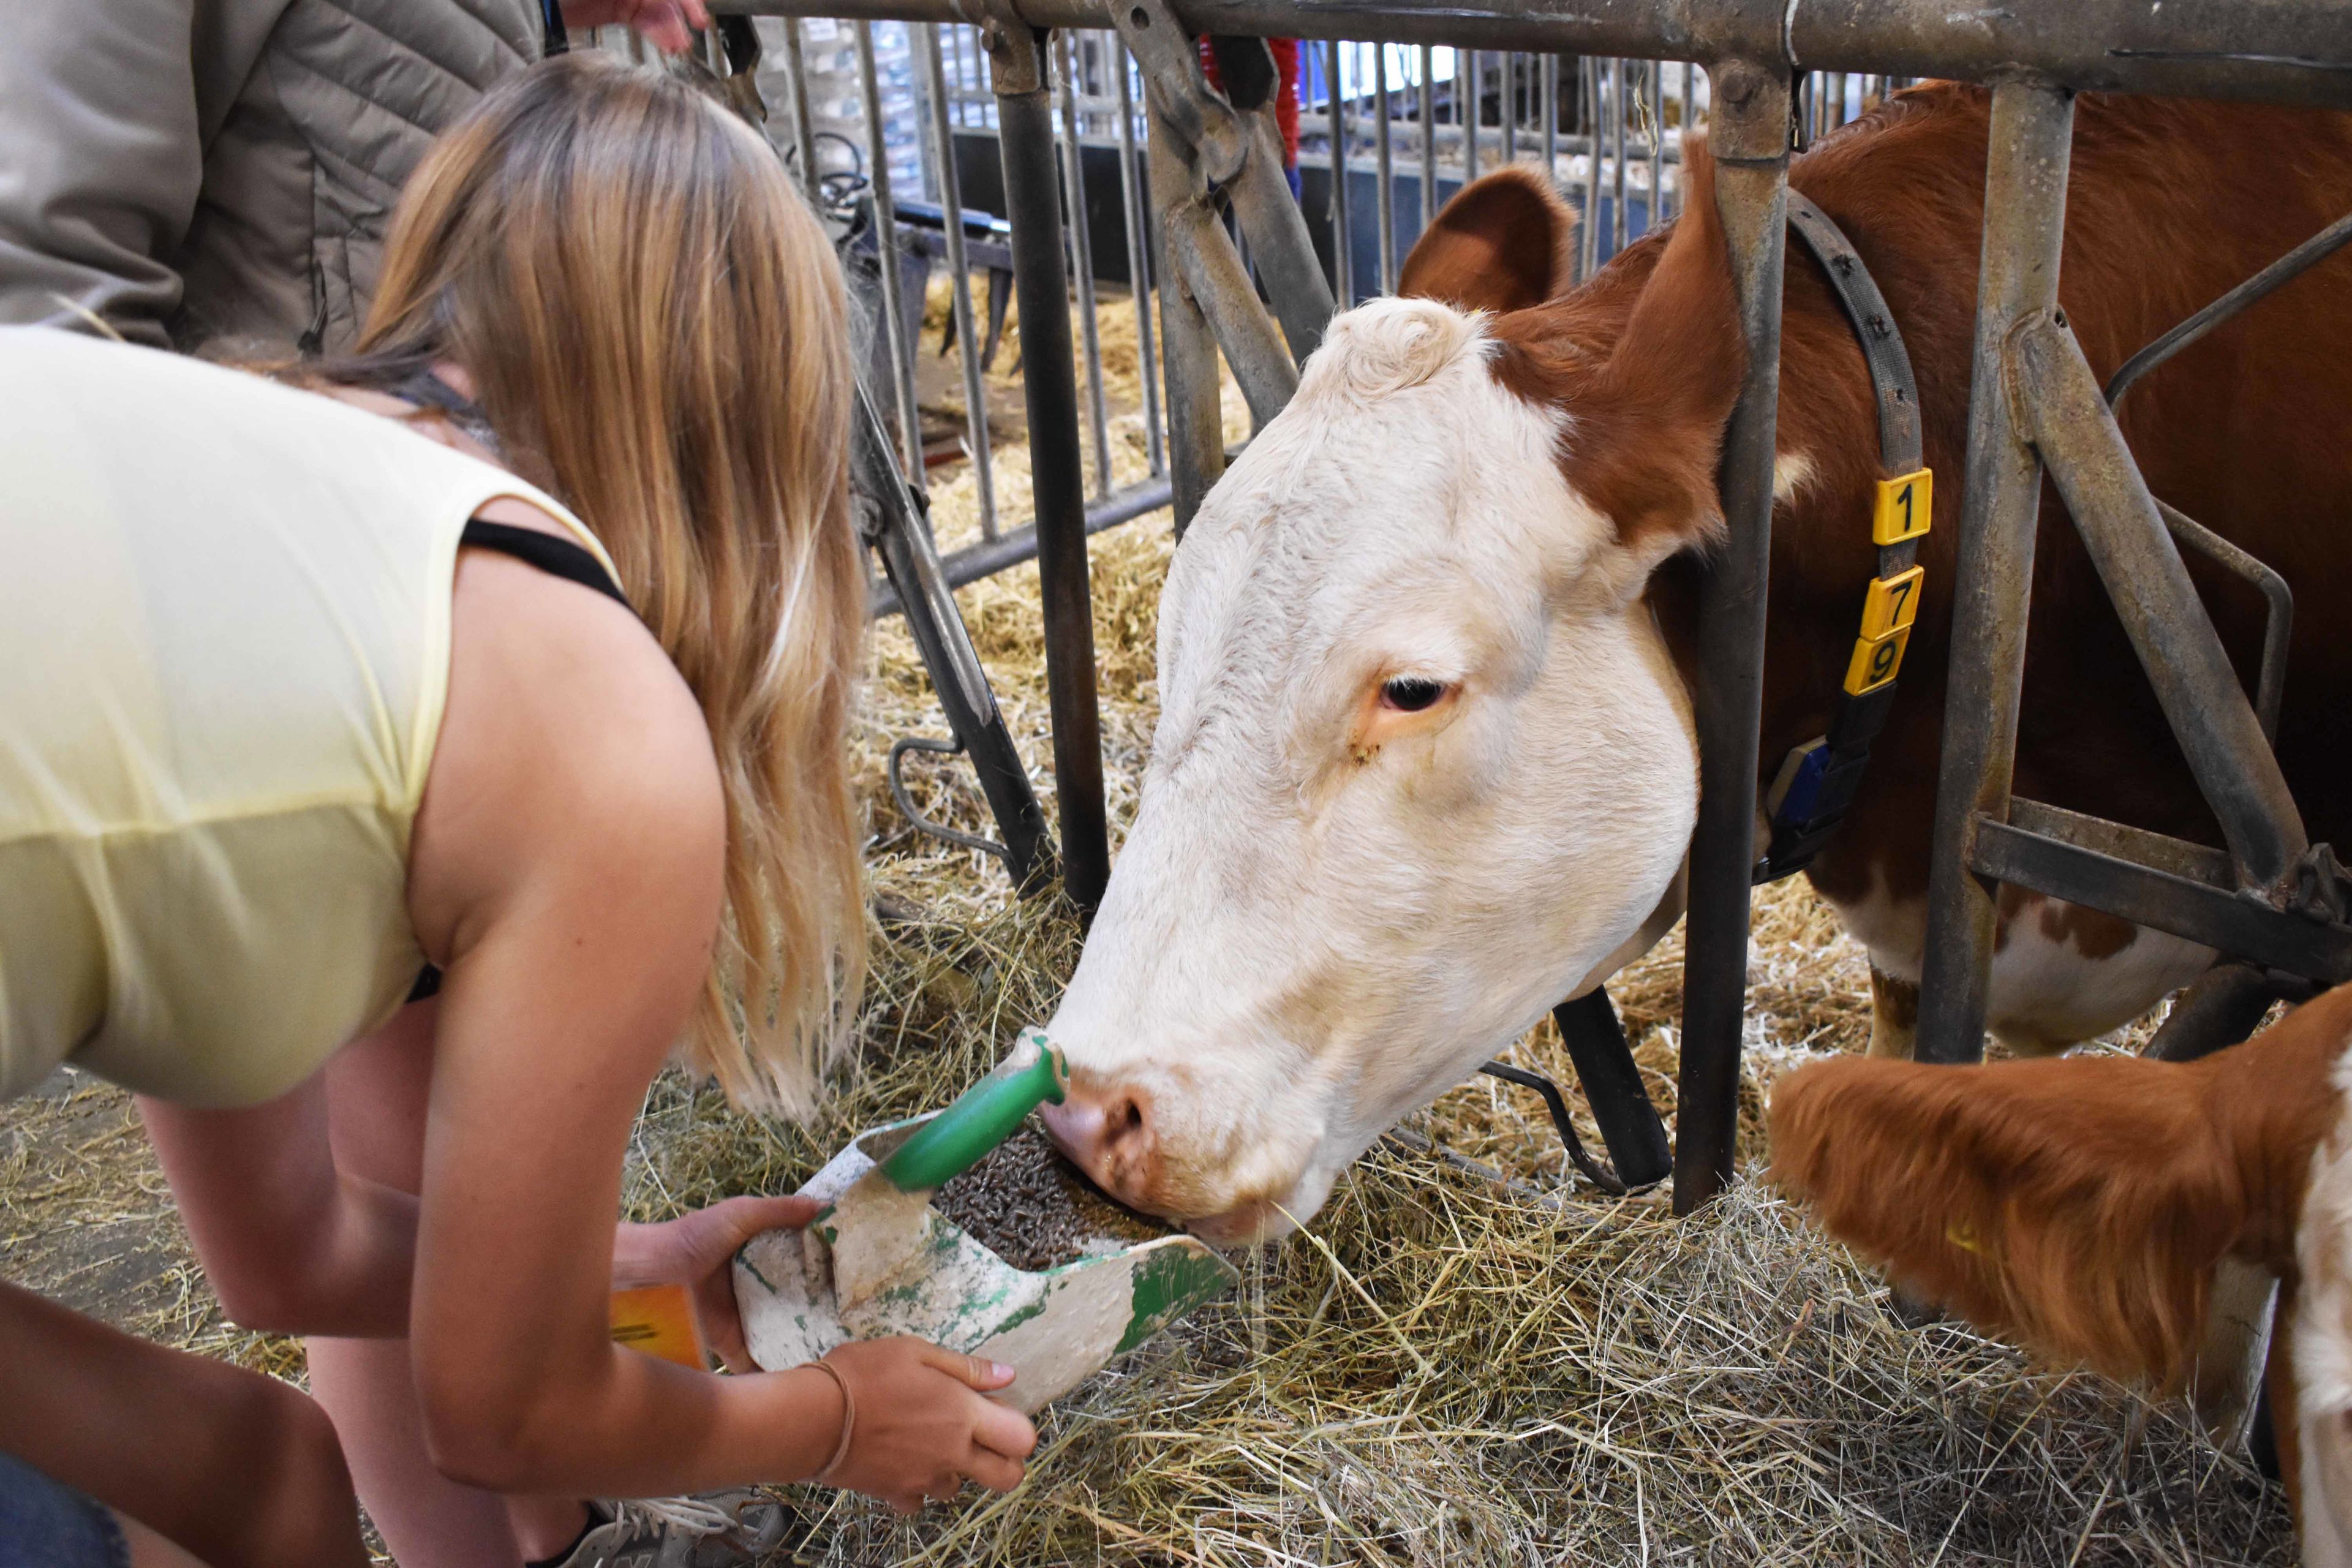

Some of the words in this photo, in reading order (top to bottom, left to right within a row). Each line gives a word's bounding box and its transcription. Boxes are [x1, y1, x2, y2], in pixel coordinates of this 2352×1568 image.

[1898, 483, 1912, 532] 1
[1891, 581, 1912, 626] 7
[1869, 641, 1896, 684] 9
